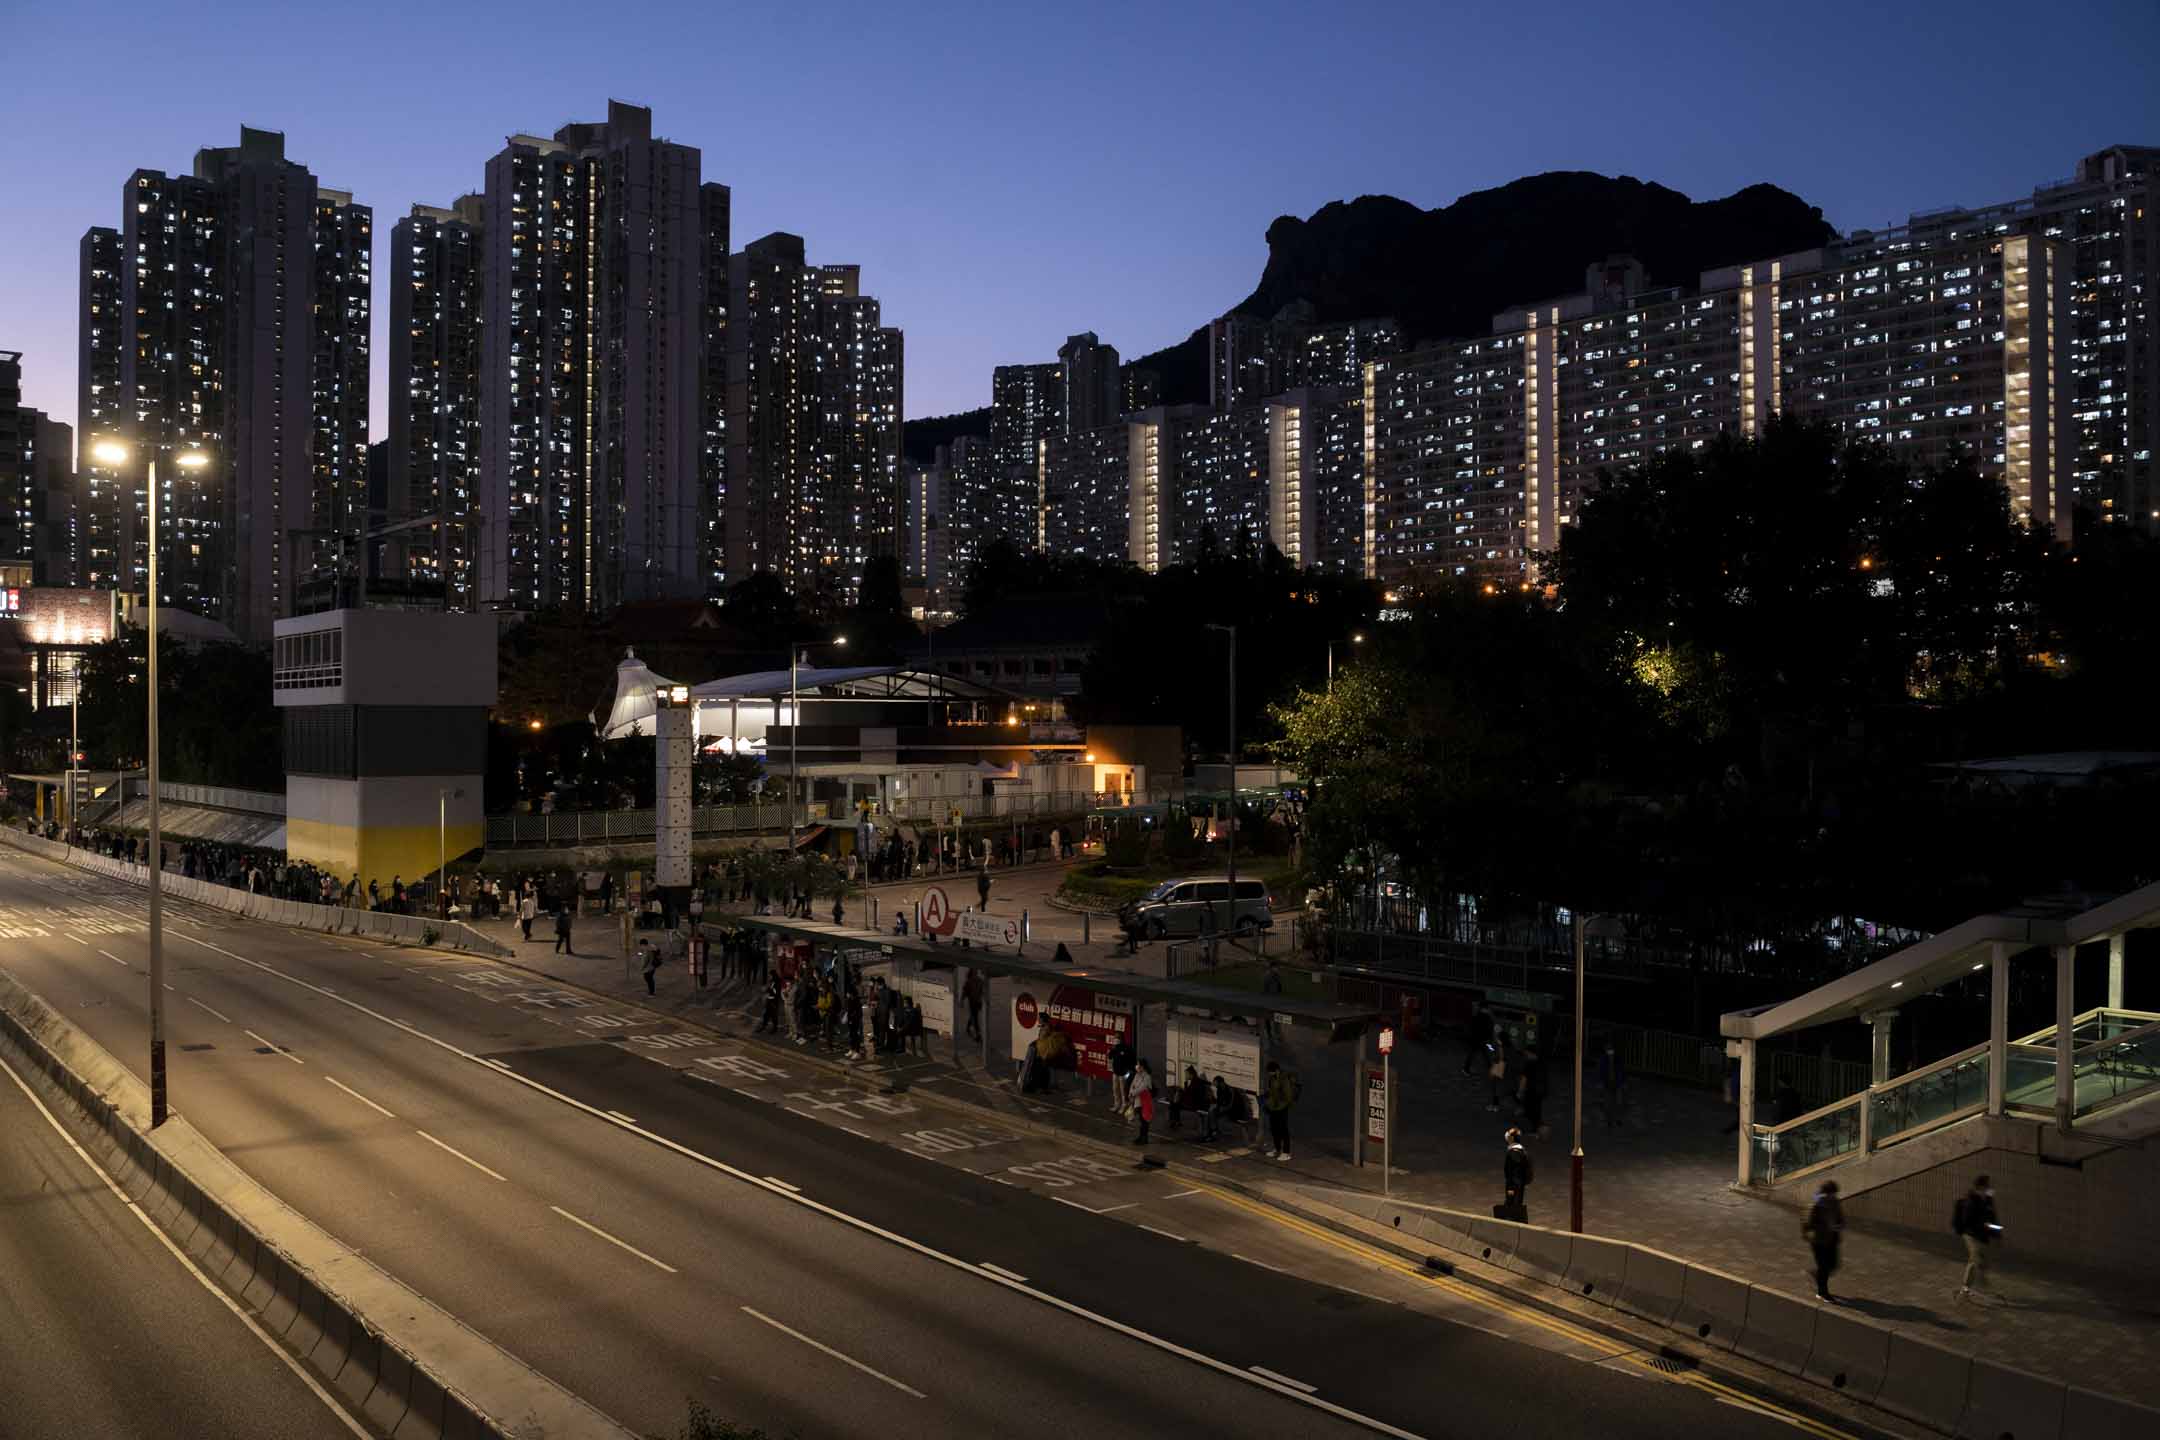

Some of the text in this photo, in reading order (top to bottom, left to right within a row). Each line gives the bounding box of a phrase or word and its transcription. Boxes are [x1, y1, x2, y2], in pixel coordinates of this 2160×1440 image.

[927, 894, 941, 922] A
[630, 1032, 718, 1049] BUS
[1008, 1157, 1135, 1187] BUS
